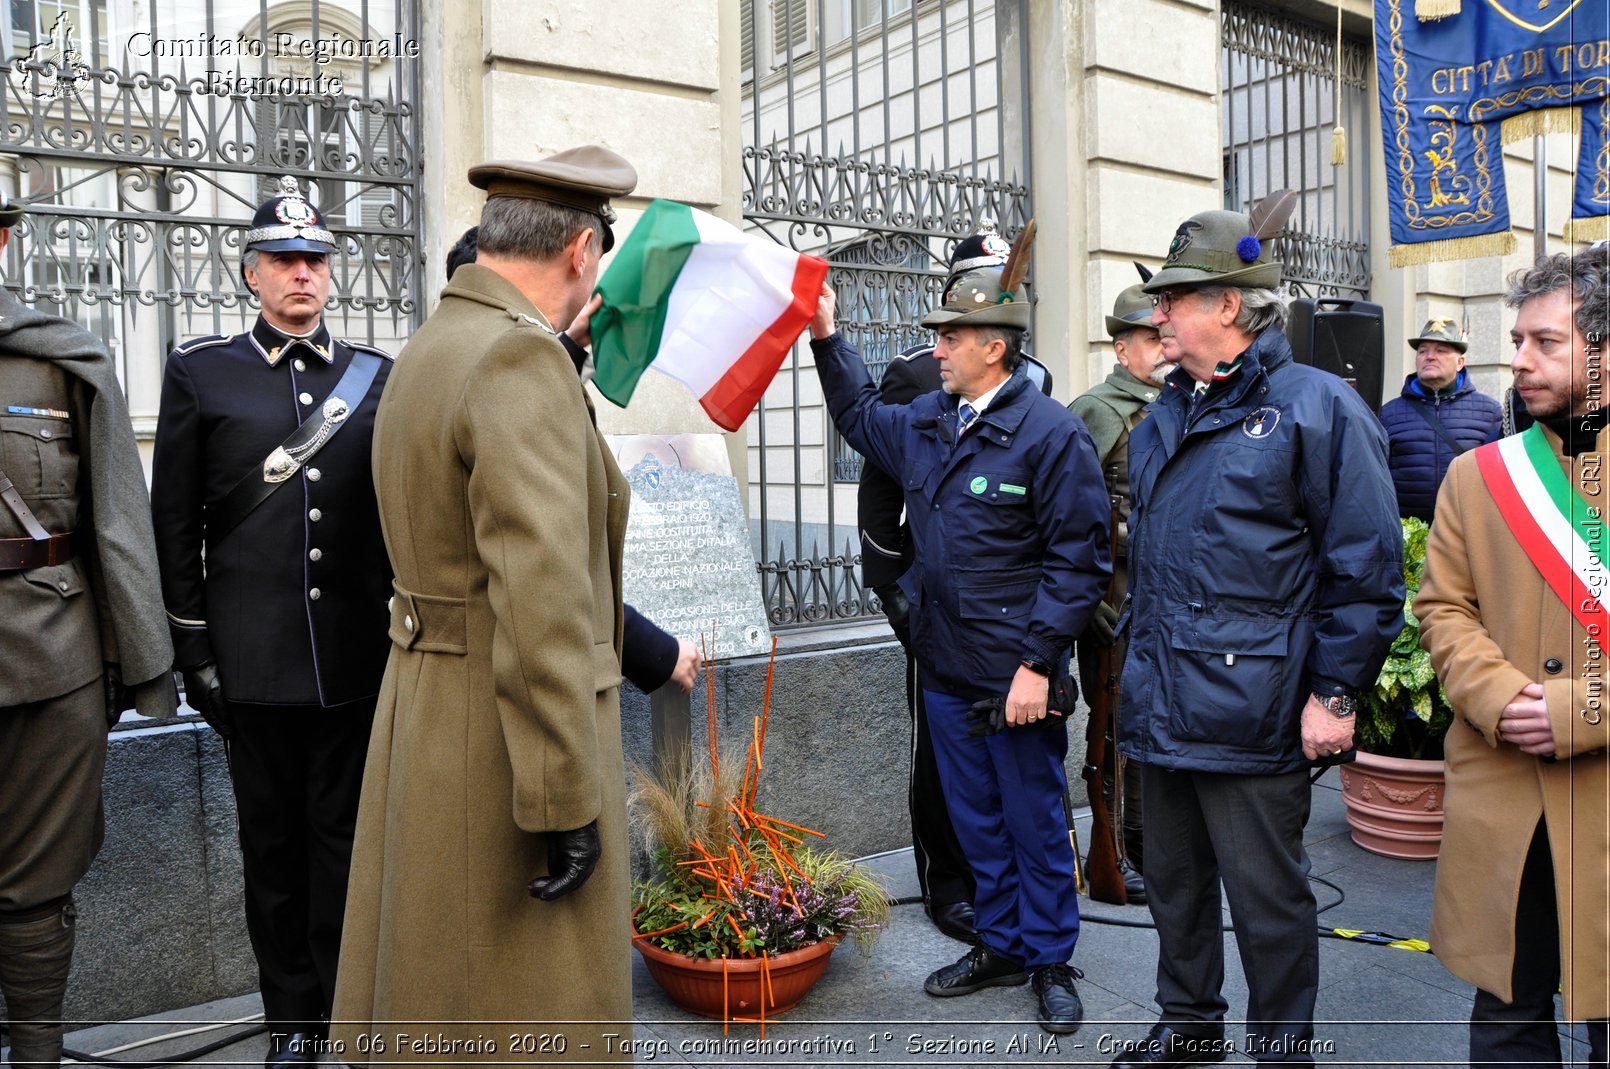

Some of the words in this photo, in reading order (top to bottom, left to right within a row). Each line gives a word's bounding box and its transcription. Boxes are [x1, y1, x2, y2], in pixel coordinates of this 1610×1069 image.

[1522, 48, 1545, 78] DI
[1555, 40, 1610, 73] TOR
[667, 500, 710, 512] EDIFICIO
[690, 512, 711, 522] 1920
[625, 528, 654, 540] ENNE
[656, 525, 713, 538] COSTITUITA
[649, 539, 696, 552] SEZIONE
[654, 553, 688, 564] DELLA
[623, 565, 681, 581] OCIAZIONE
[684, 561, 743, 575] NAZIONALE
[659, 579, 693, 590] ALPINI
[656, 604, 718, 620] OCCASIONE
[721, 600, 752, 613] DELLE
[724, 614, 746, 626] SUO
[676, 630, 720, 643] TENARIO
